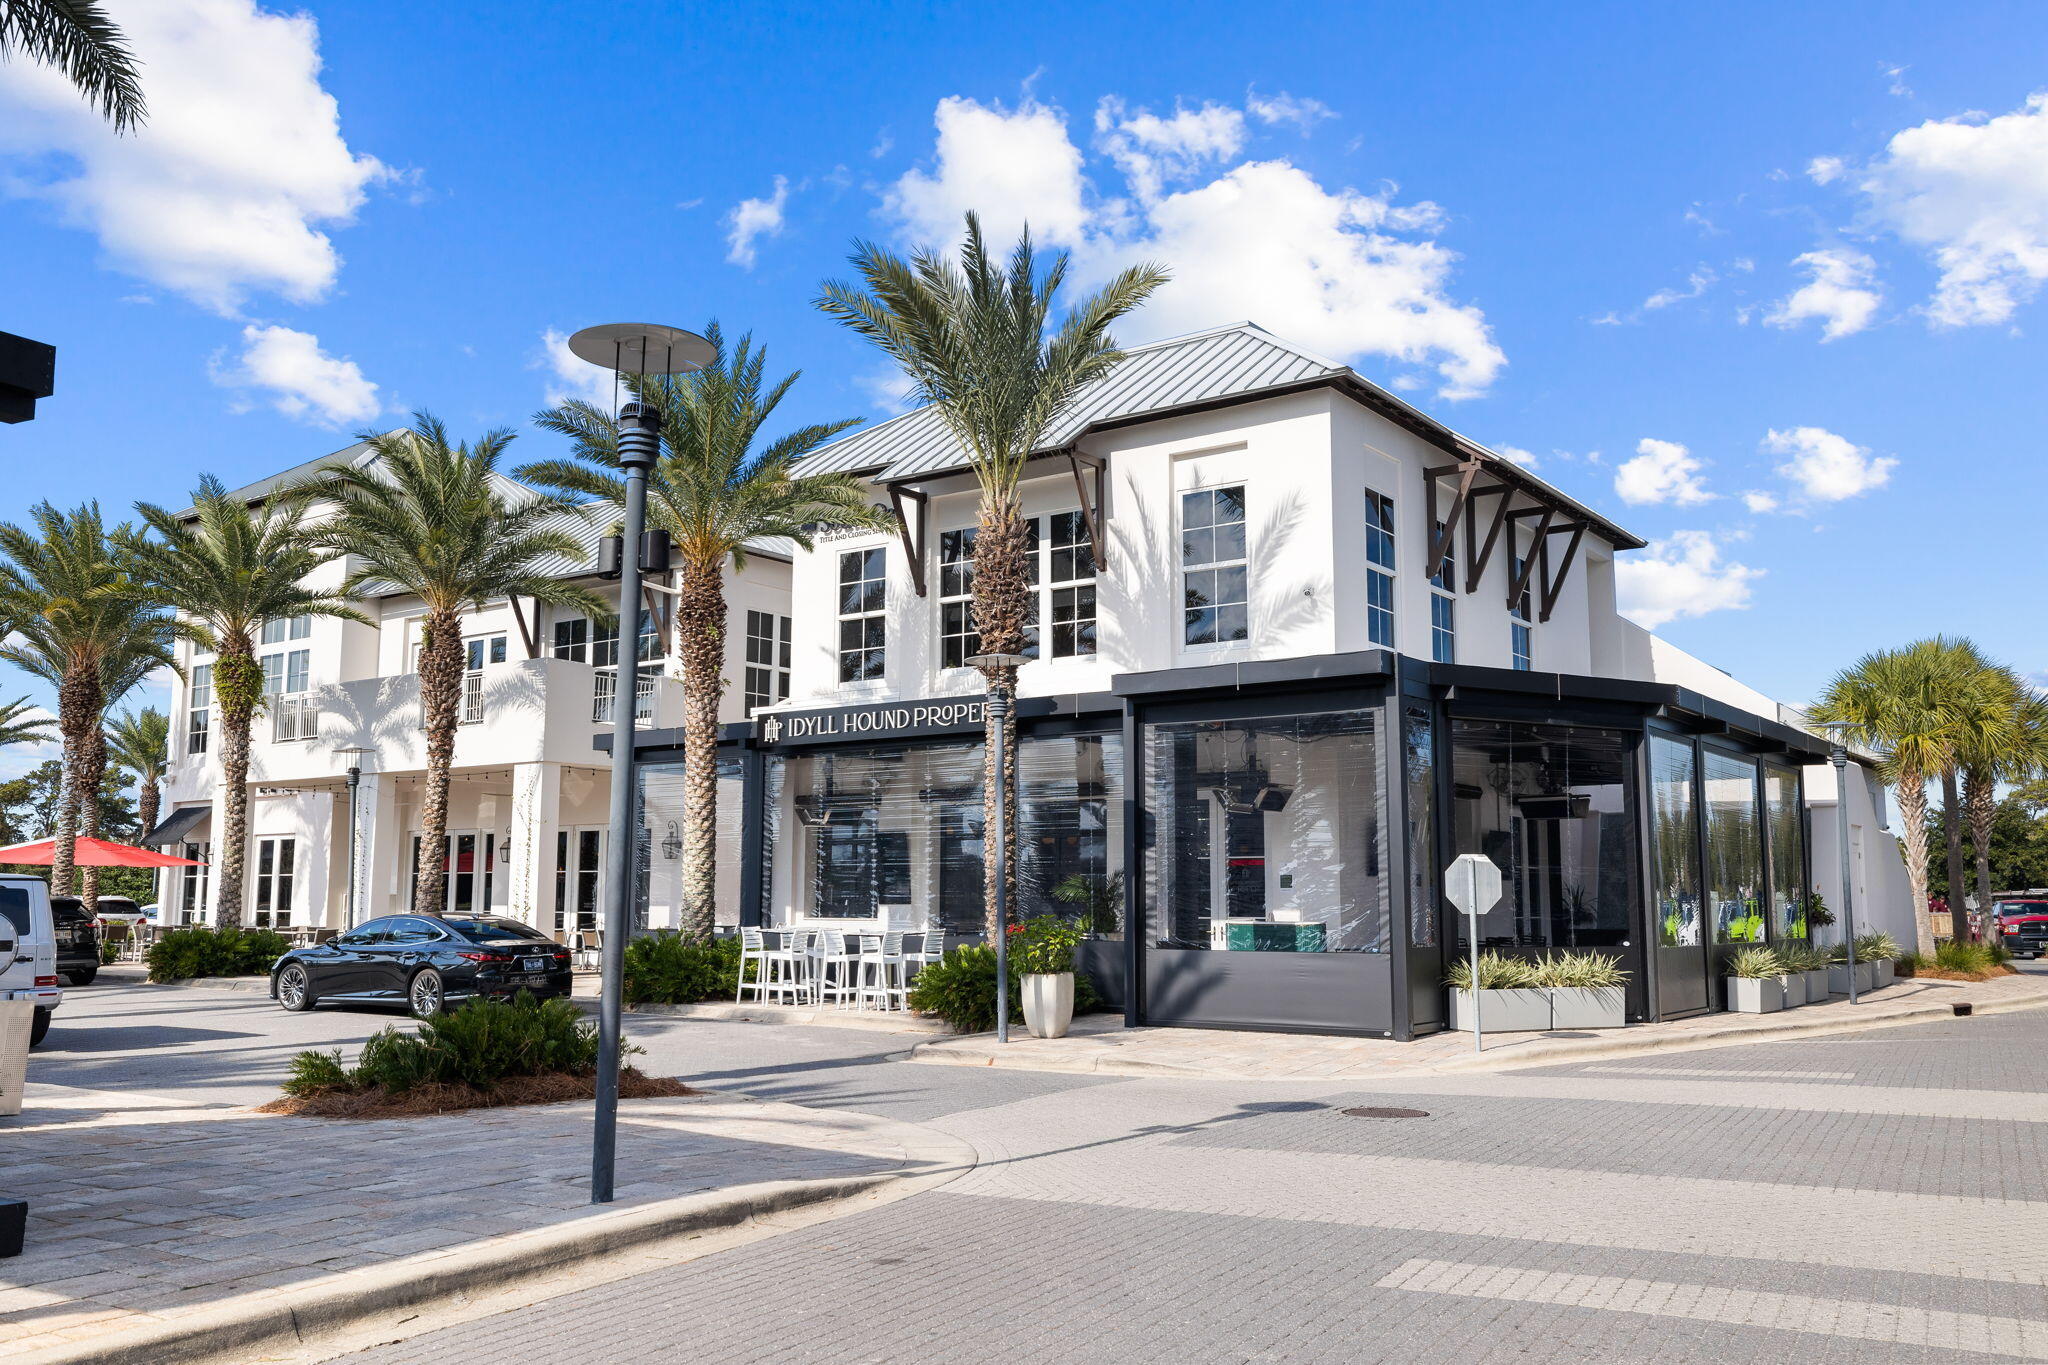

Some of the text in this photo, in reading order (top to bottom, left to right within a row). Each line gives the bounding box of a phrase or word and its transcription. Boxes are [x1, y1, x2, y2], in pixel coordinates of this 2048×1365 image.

[848, 530, 872, 539] CLOSING
[788, 714, 838, 737] IDYLL
[843, 709, 910, 733] HOUND
